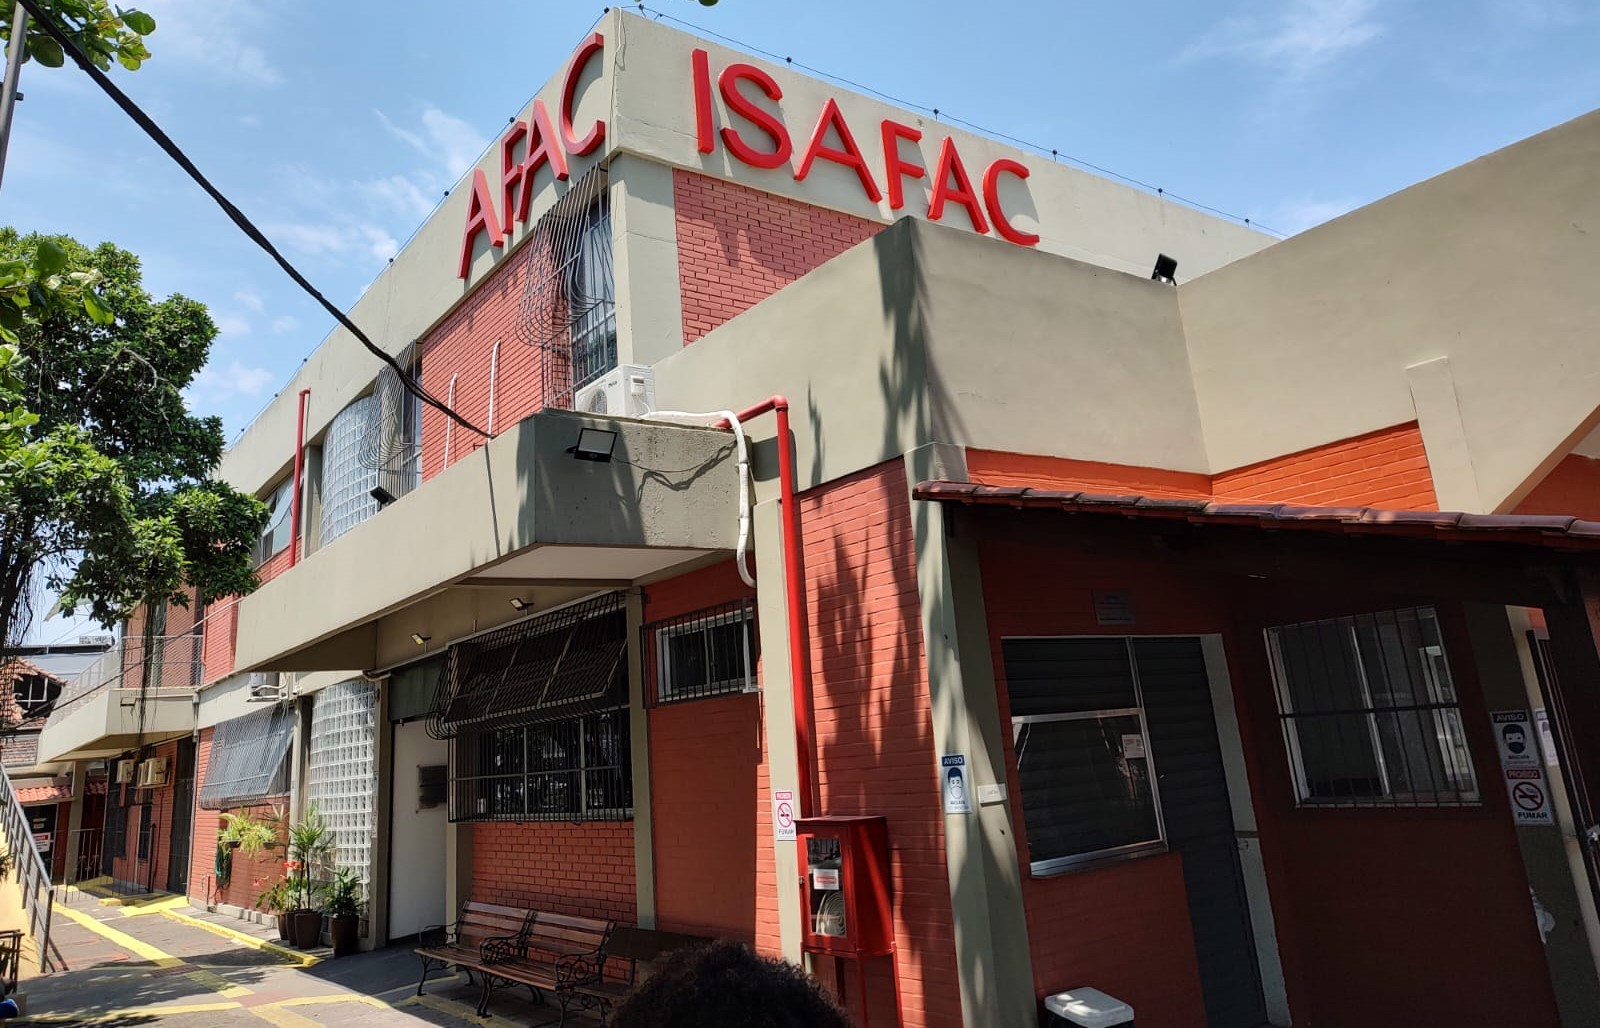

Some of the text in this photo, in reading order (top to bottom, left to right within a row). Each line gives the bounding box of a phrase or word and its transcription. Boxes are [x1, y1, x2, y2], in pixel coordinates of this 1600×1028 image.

[691, 48, 1039, 246] ISAFAC
[458, 32, 604, 279] AFAC
[1496, 713, 1524, 723] AVISO
[943, 756, 963, 765] AVISO
[1518, 811, 1547, 819] FUMAR
